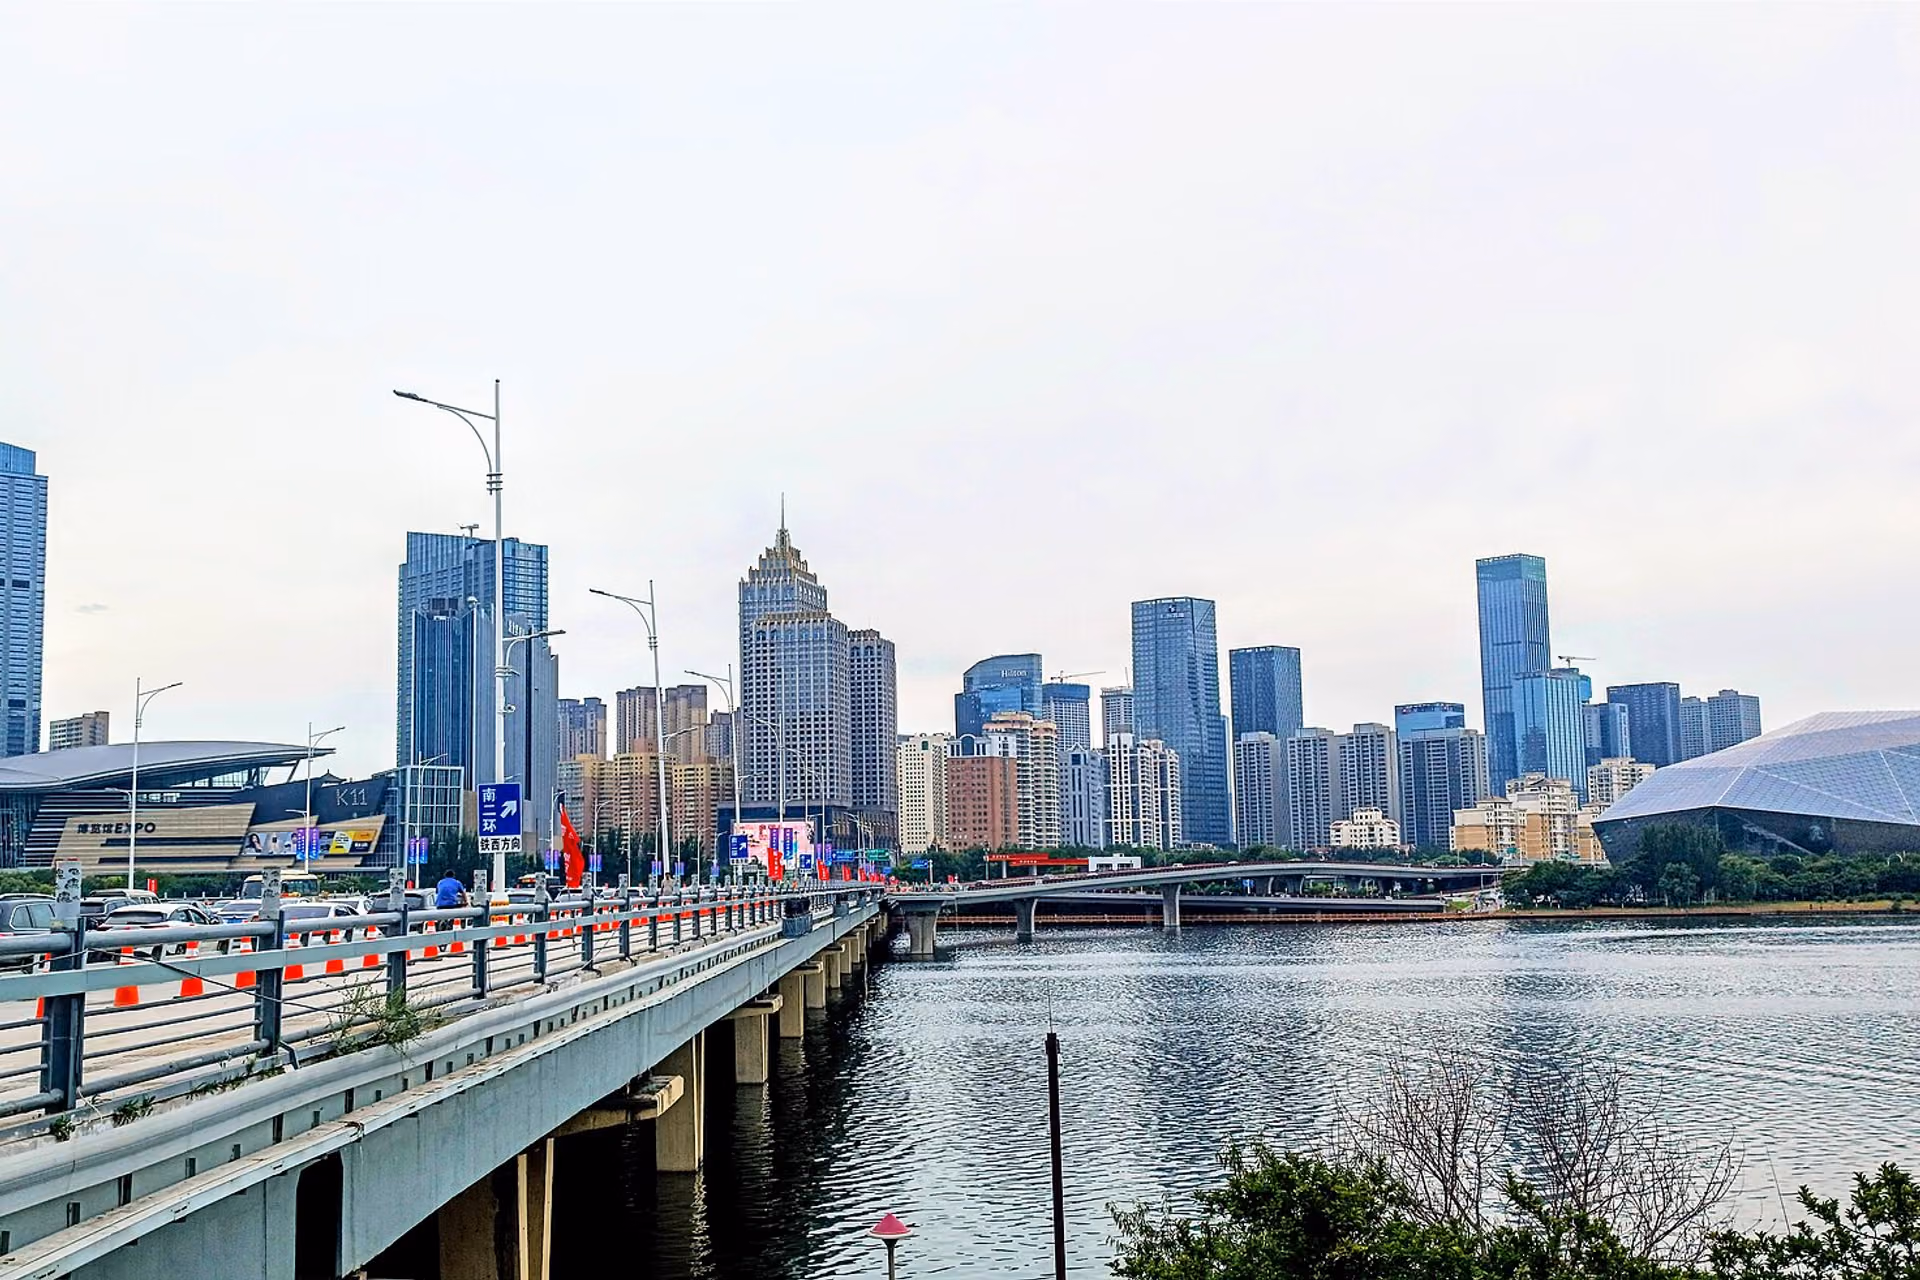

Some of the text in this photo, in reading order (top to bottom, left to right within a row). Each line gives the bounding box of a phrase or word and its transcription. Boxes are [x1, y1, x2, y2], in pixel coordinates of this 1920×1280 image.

[336, 788, 368, 806] K11
[482, 787, 497, 833] 南二环
[480, 837, 520, 851] 铁西方向
